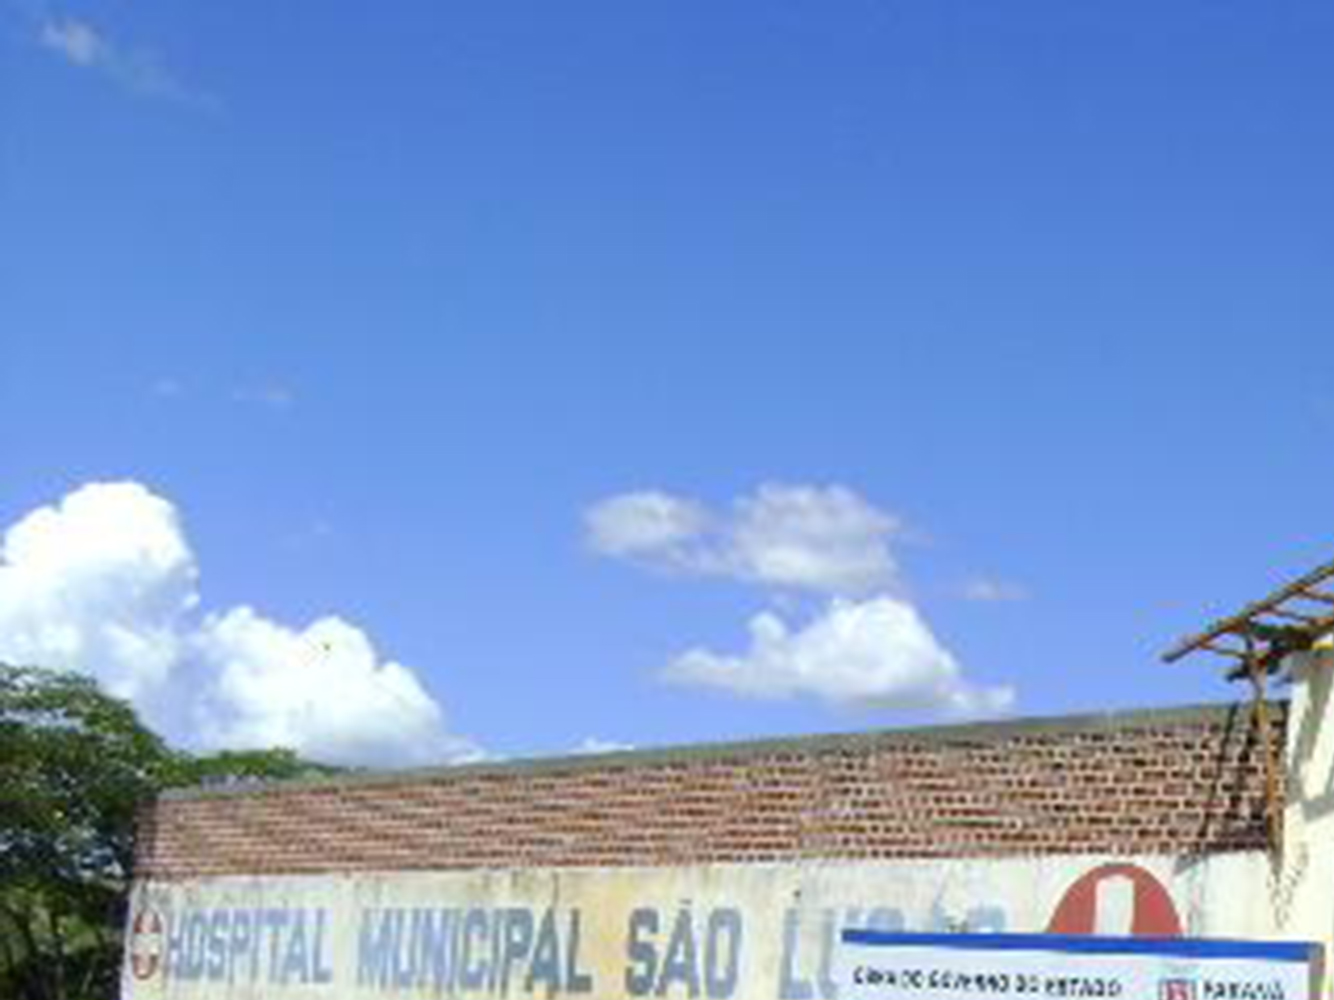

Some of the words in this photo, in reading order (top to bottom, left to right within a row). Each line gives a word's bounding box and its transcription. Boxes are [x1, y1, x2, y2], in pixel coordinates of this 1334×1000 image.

[167, 907, 334, 985] HOSPITAL
[357, 906, 592, 999] MUNICIPAL
[623, 899, 743, 1000] SÃO
